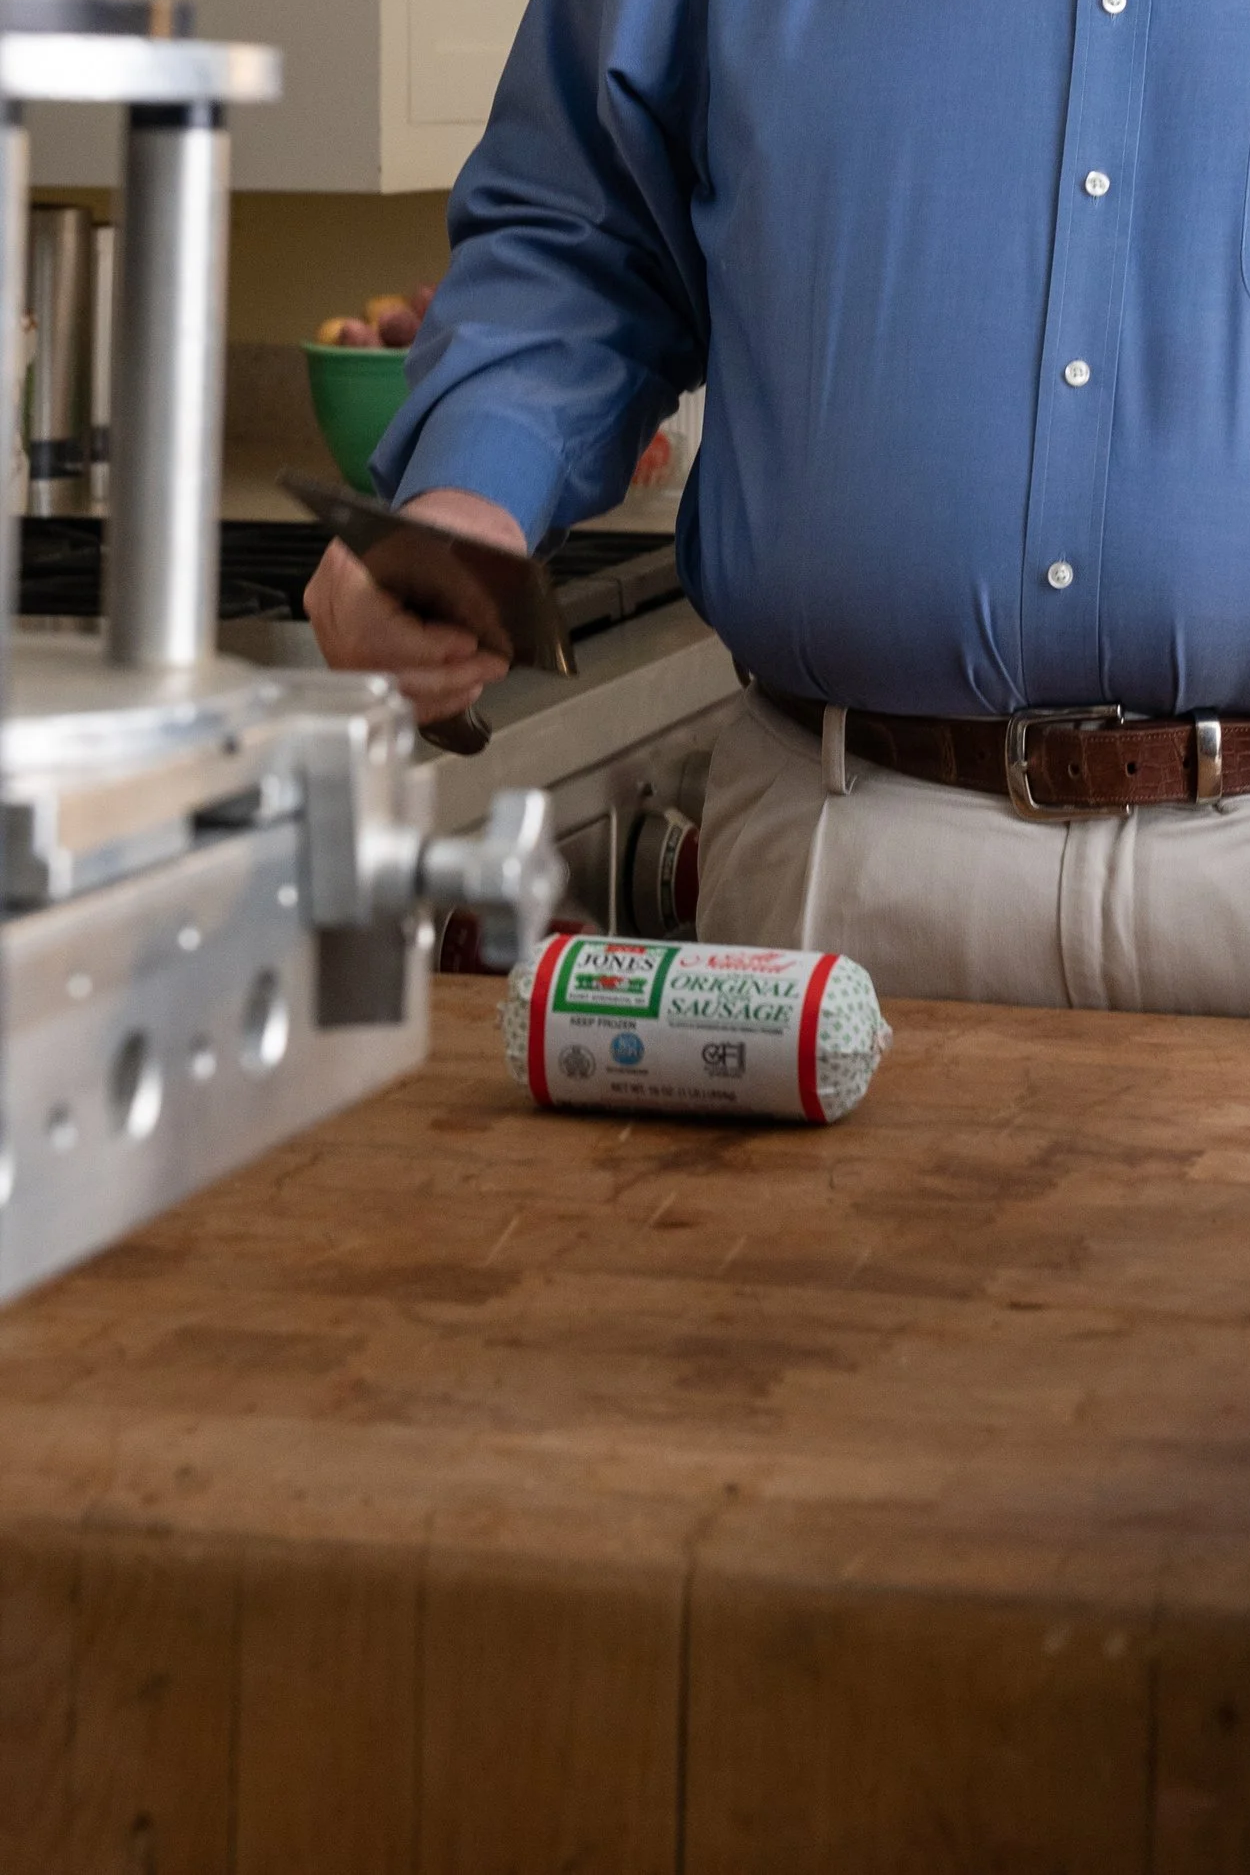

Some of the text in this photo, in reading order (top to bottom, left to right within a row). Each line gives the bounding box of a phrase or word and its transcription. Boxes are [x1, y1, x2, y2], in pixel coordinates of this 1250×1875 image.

[578, 953, 656, 971] JONES
[670, 974, 800, 999] ORIGINAL
[667, 997, 794, 1023] SAUSAGE
